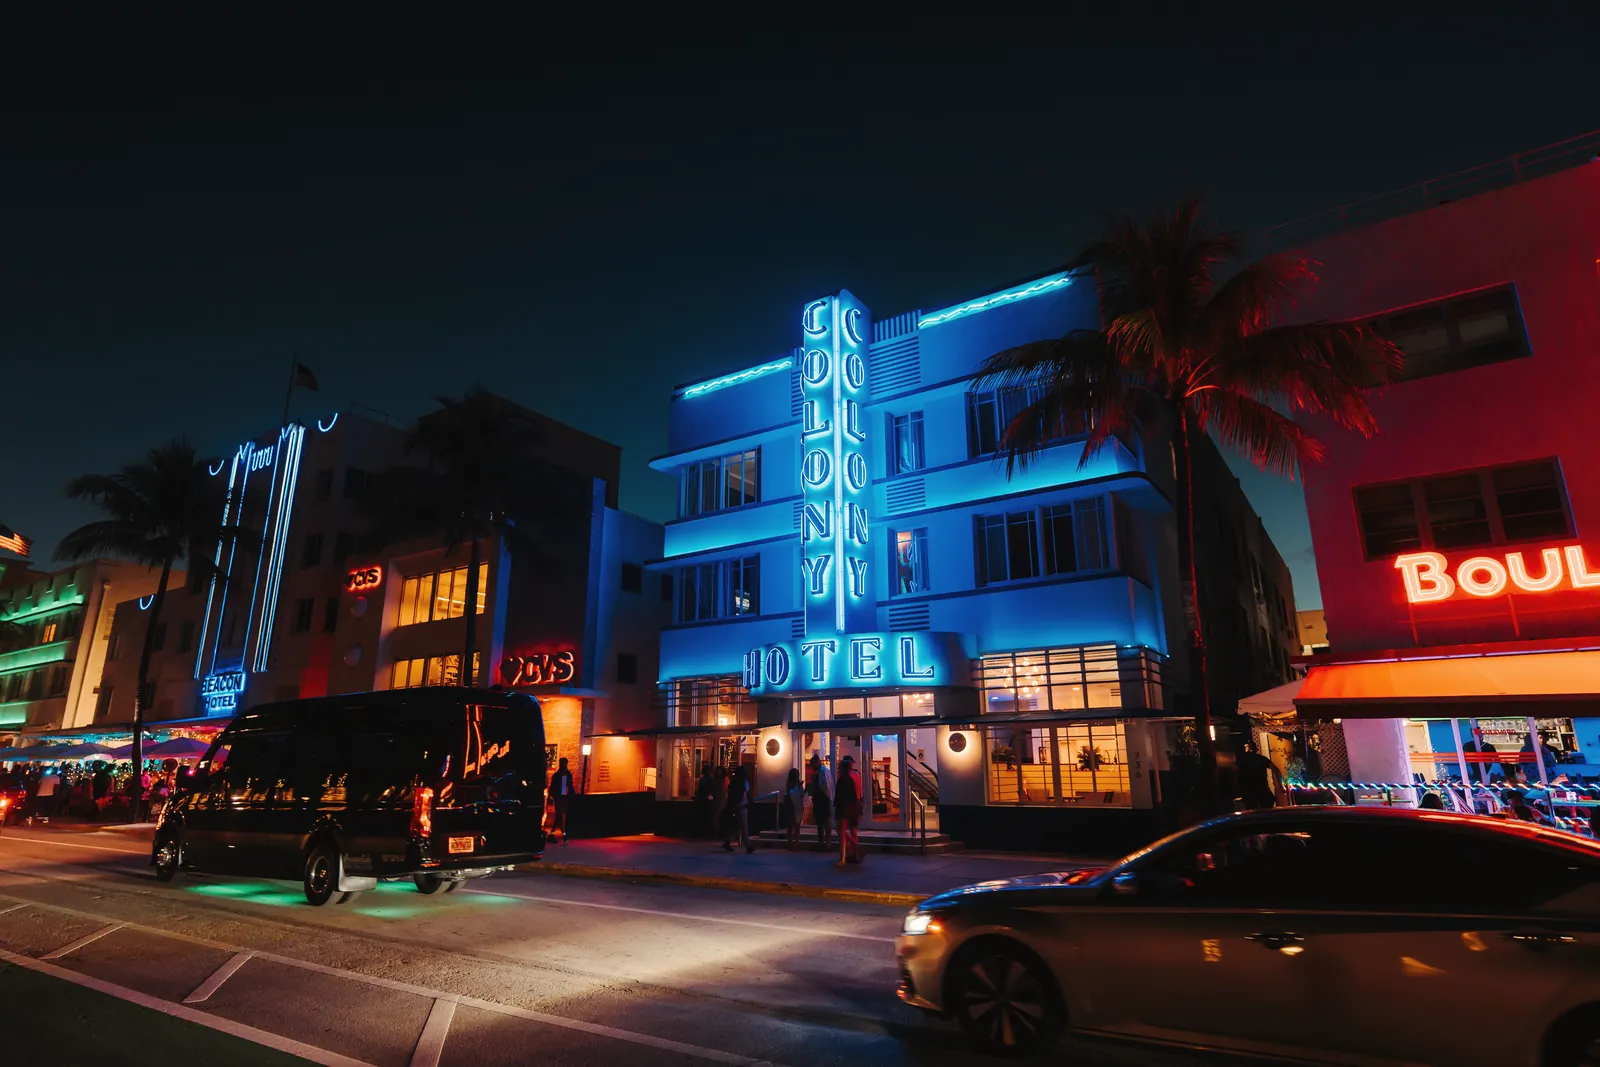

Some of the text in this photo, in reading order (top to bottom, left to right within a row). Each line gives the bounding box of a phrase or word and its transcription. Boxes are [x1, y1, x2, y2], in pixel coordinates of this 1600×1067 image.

[803, 301, 831, 594] COLONY
[845, 308, 868, 597] COLONY
[354, 568, 380, 587] CVS
[1394, 545, 1600, 603] BOUL
[522, 651, 574, 685] CVS
[743, 637, 935, 689] HOTEL
[202, 673, 245, 693] BEACON
[205, 695, 235, 709] HOTEL
[1134, 752, 1142, 778] 736
